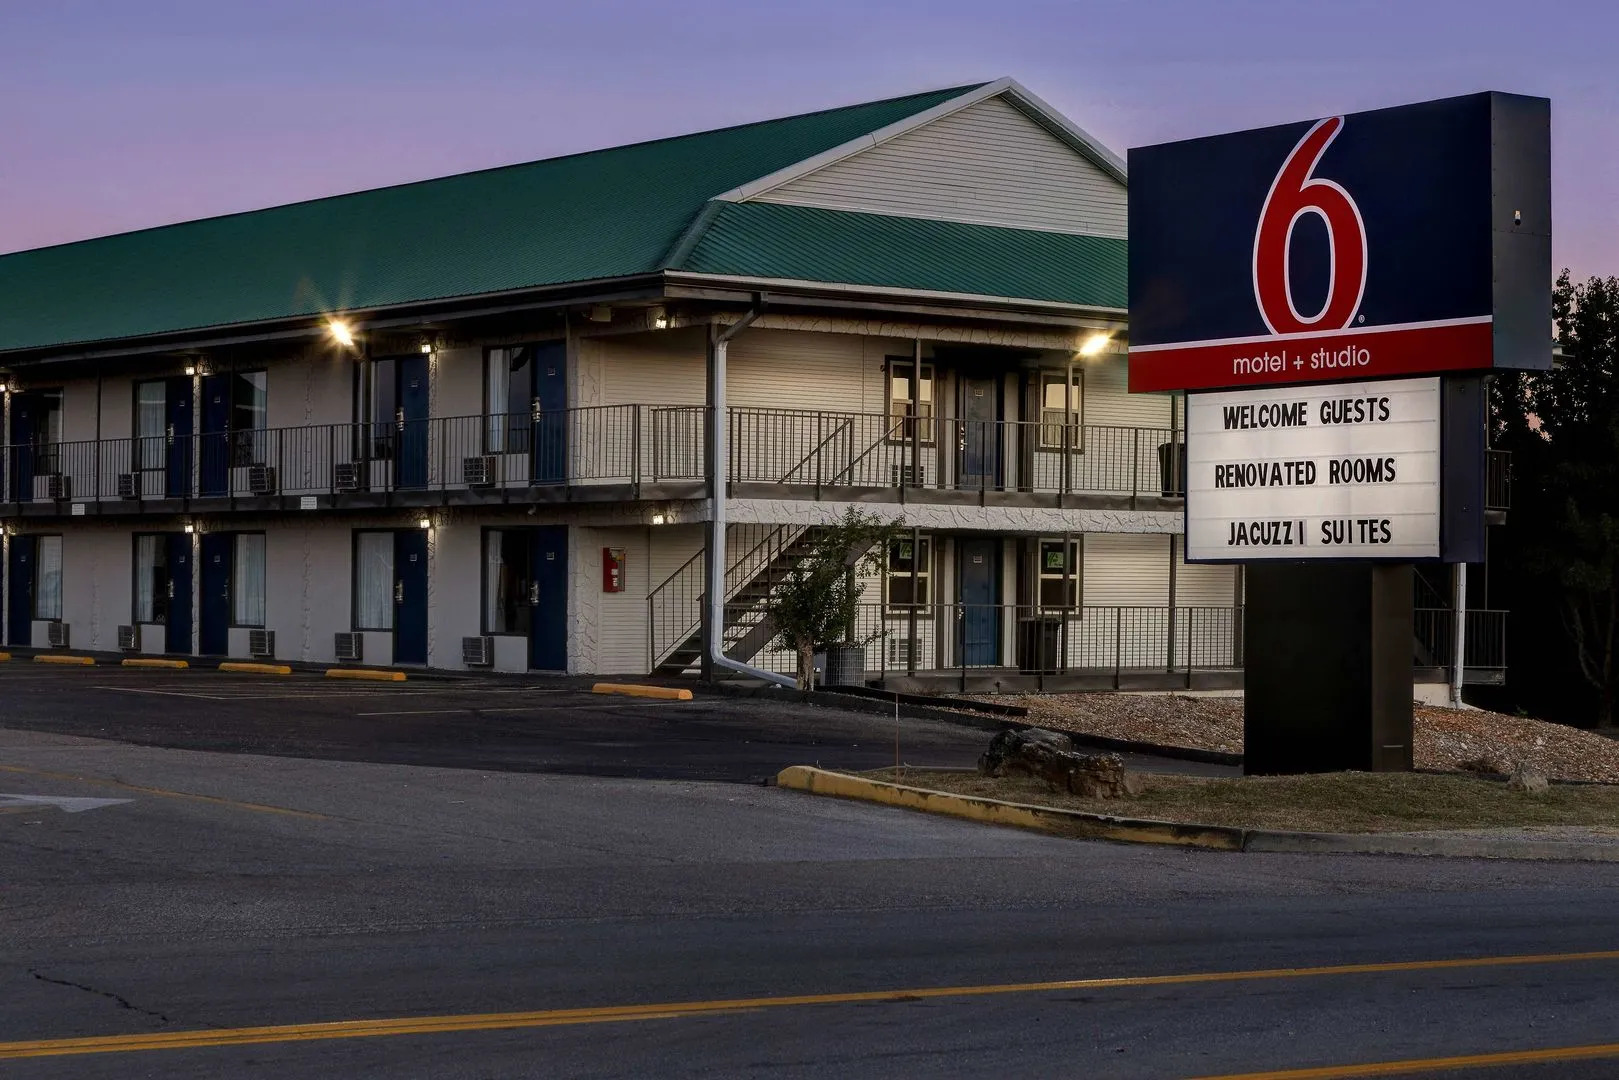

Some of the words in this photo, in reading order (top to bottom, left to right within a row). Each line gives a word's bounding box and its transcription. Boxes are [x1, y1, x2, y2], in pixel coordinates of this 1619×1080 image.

[1253, 115, 1368, 335] 6
[1233, 351, 1287, 374] motel
[1311, 345, 1371, 368] studio
[1223, 402, 1308, 430] WELCOME
[1320, 397, 1390, 424] GUESTS
[1215, 460, 1316, 488] RENOVATED
[1329, 458, 1396, 485] ROOMS
[1228, 521, 1304, 546] JACUZZI
[1321, 519, 1392, 545] SUITES
